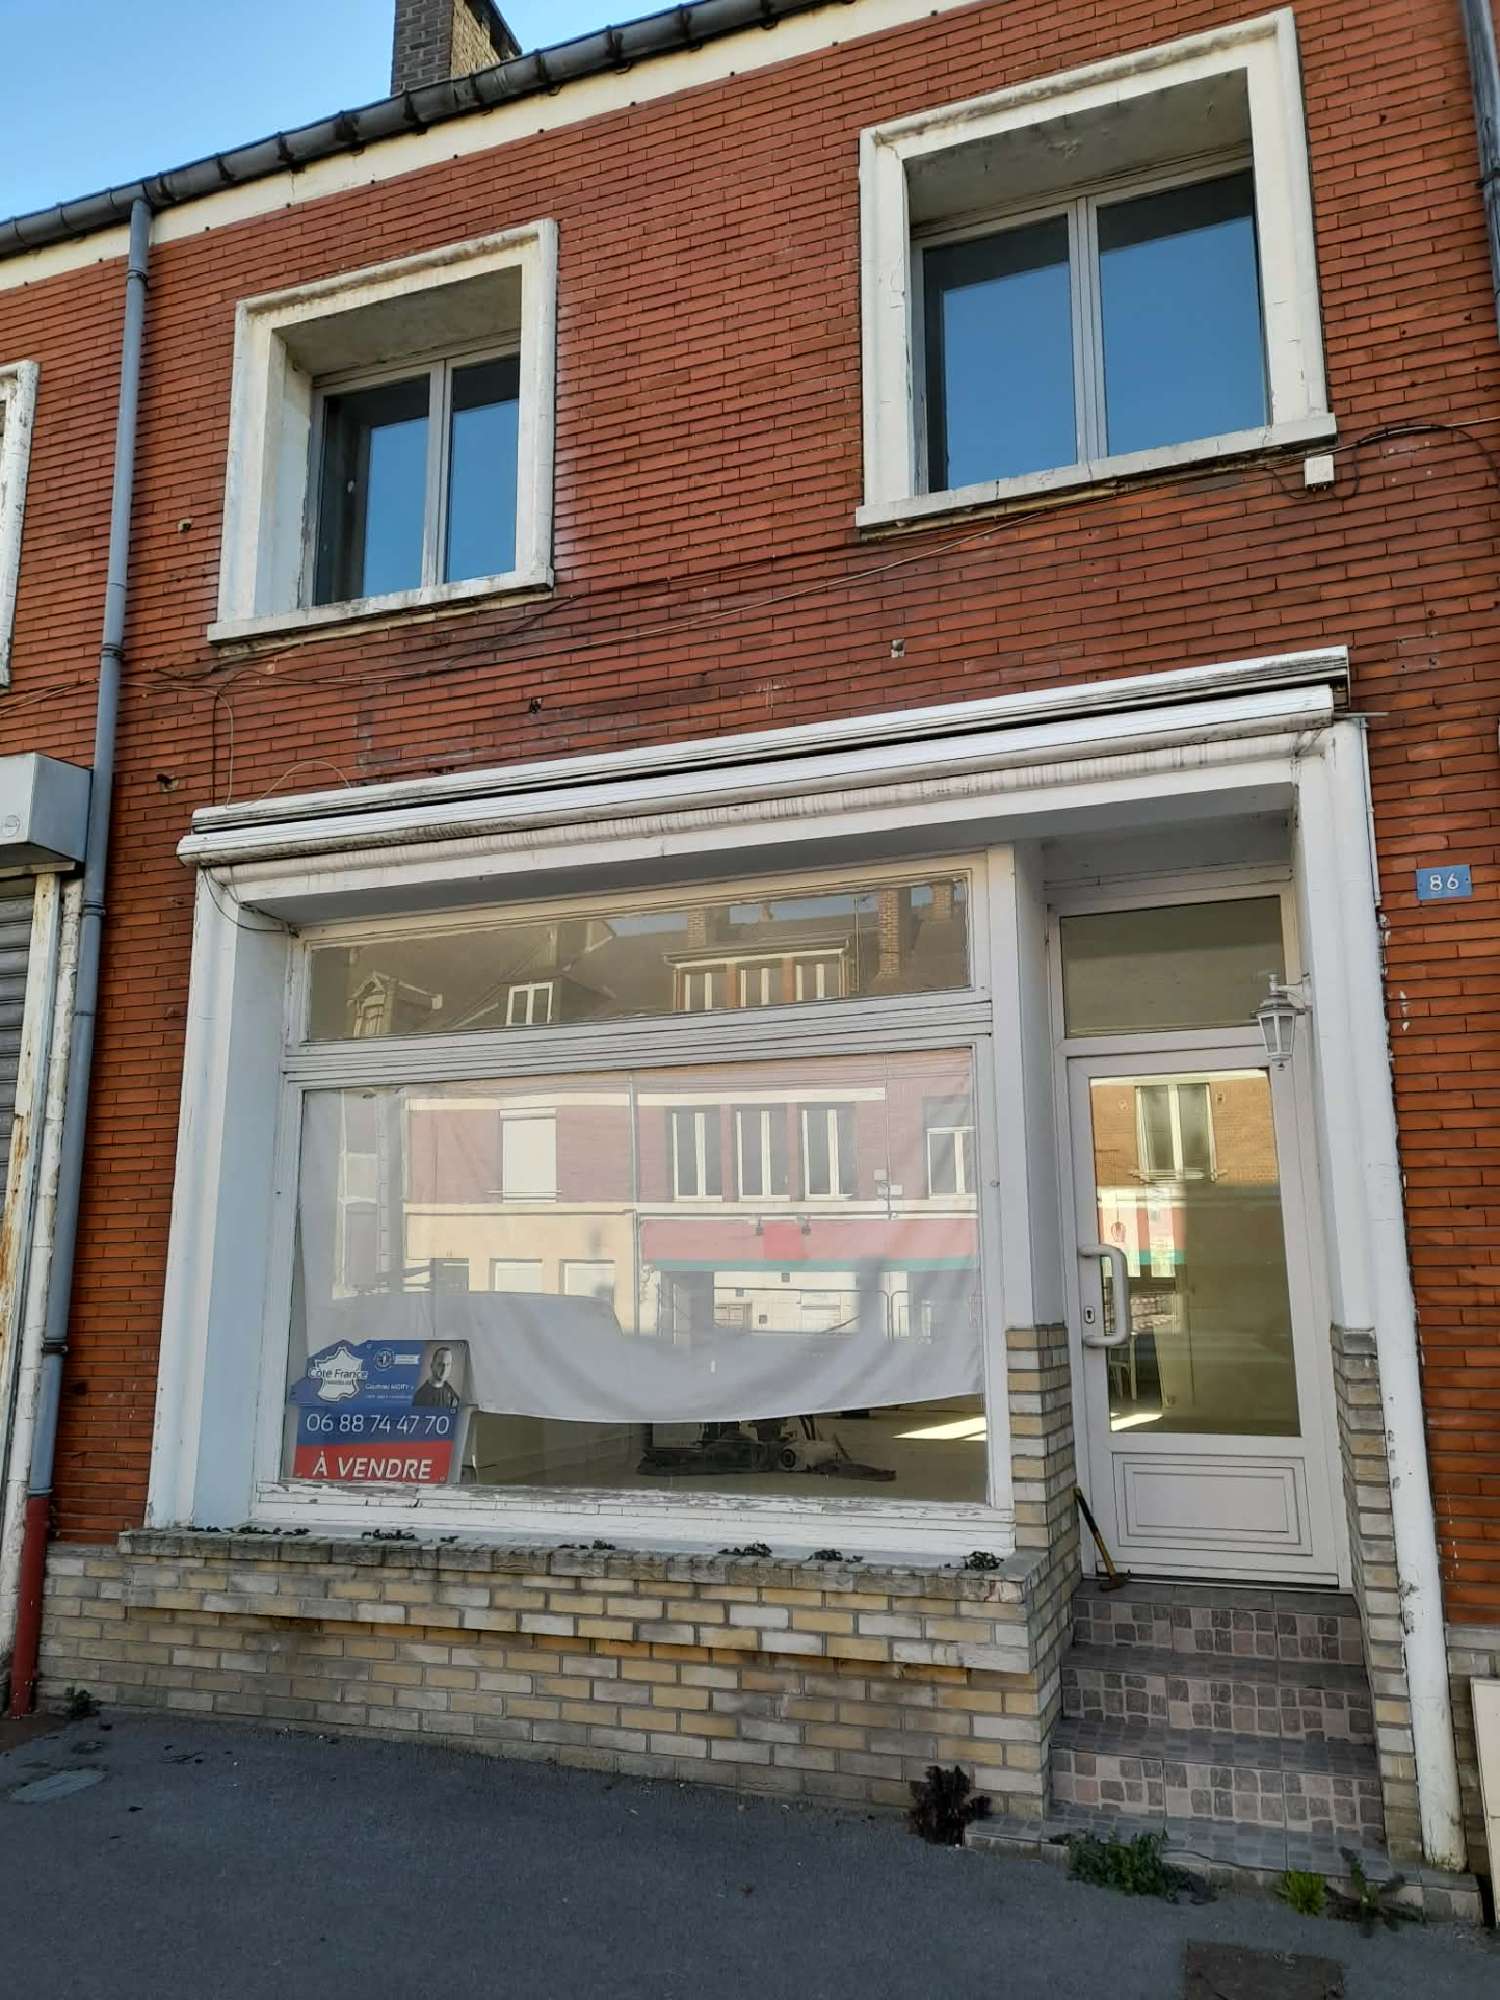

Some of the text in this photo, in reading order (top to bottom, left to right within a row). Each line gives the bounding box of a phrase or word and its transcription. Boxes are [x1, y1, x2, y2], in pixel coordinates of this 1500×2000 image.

[1430, 873, 1459, 891] 86
[334, 1368, 369, 1380] France
[306, 1413, 450, 1434] 06 88 74 47 70
[313, 1450, 433, 1479] À VENDRE
